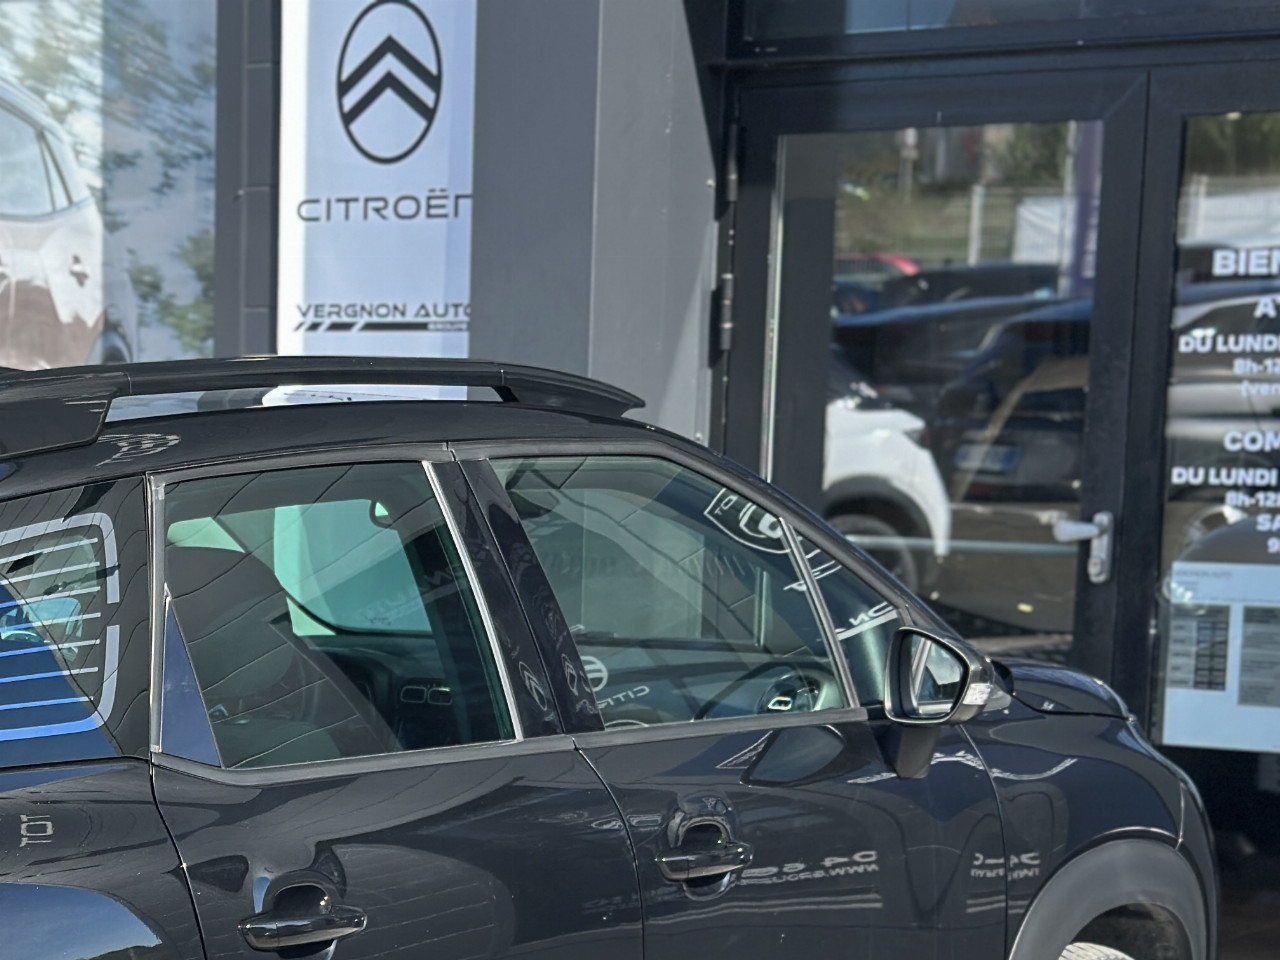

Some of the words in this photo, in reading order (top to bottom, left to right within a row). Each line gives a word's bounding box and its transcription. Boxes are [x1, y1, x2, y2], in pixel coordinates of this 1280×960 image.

[296, 303, 406, 319] VERGNON
[414, 303, 469, 318] AUTO
[1178, 335, 1214, 353] DU
[1216, 334, 1280, 352] LUND
[1171, 466, 1205, 485] DU
[1208, 467, 1278, 486] LUNDI
[1225, 490, 1280, 508] 8h-12
